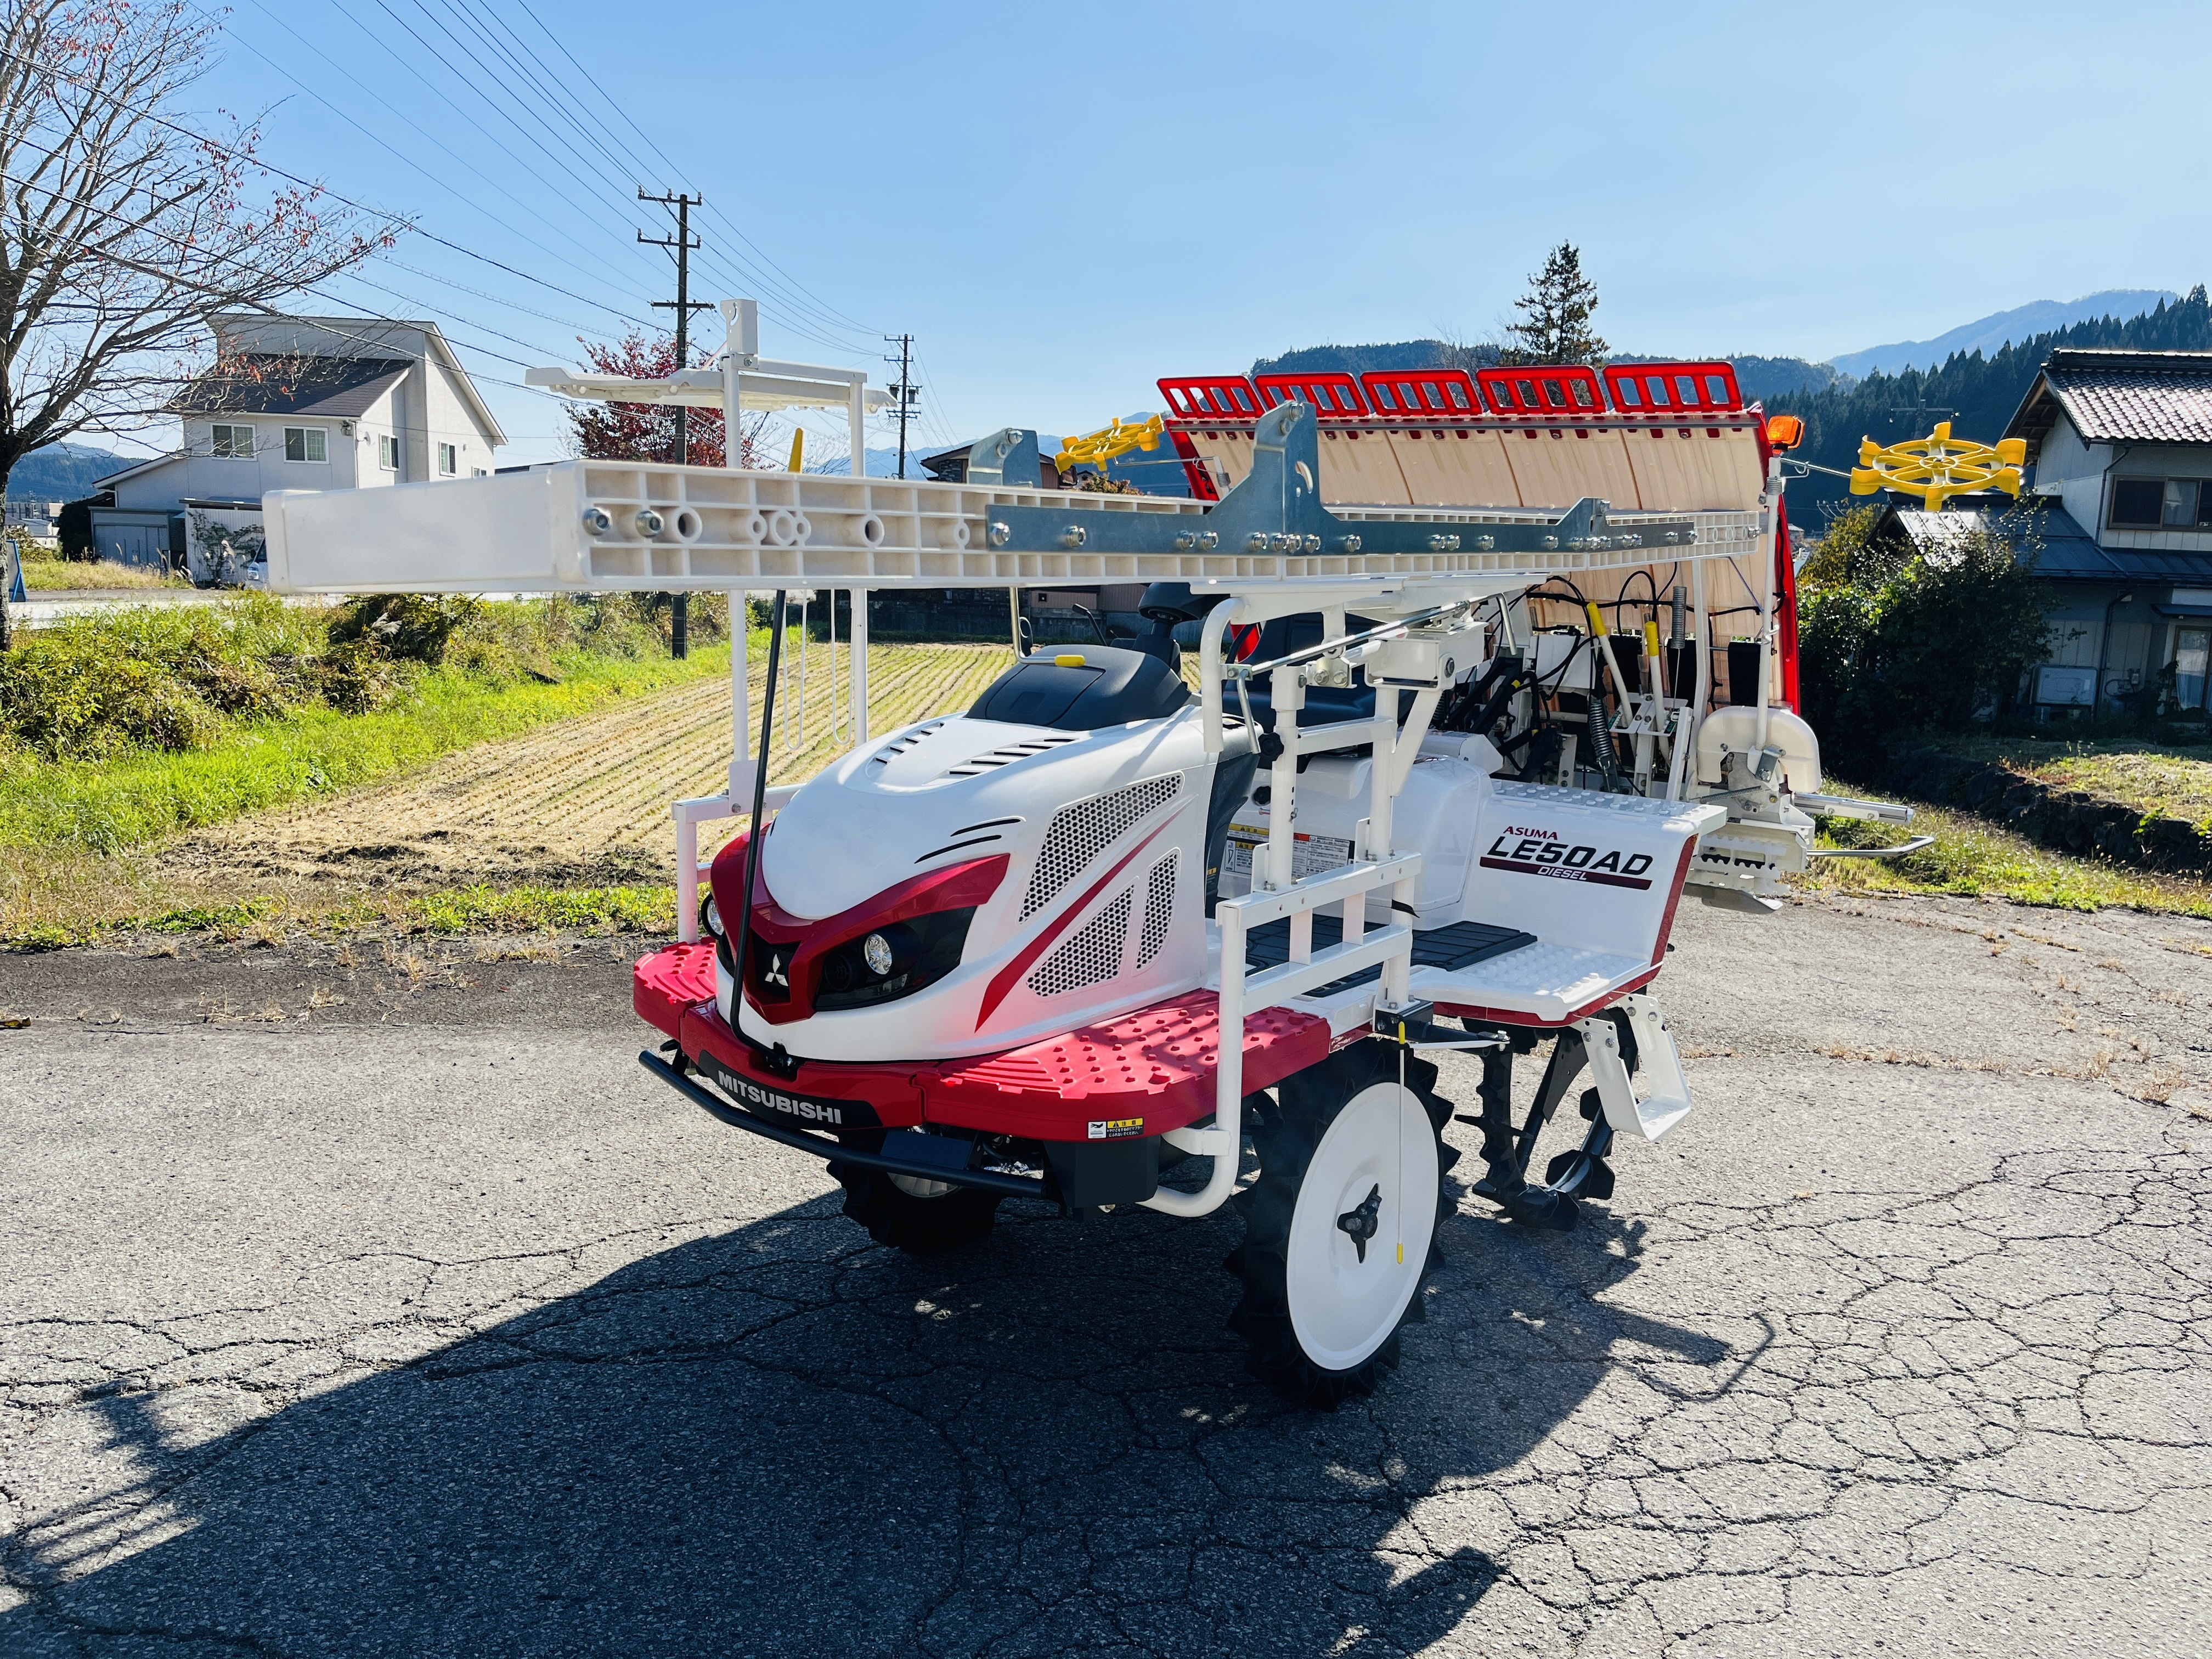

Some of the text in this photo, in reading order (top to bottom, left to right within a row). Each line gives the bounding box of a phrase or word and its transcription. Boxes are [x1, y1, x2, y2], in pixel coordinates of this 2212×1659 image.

[1503, 826, 1558, 840] ASUMA
[1487, 836, 1654, 876] LE50AD
[1537, 866, 1587, 881] DIESEL
[718, 1070, 842, 1124] MITSUBISHI
